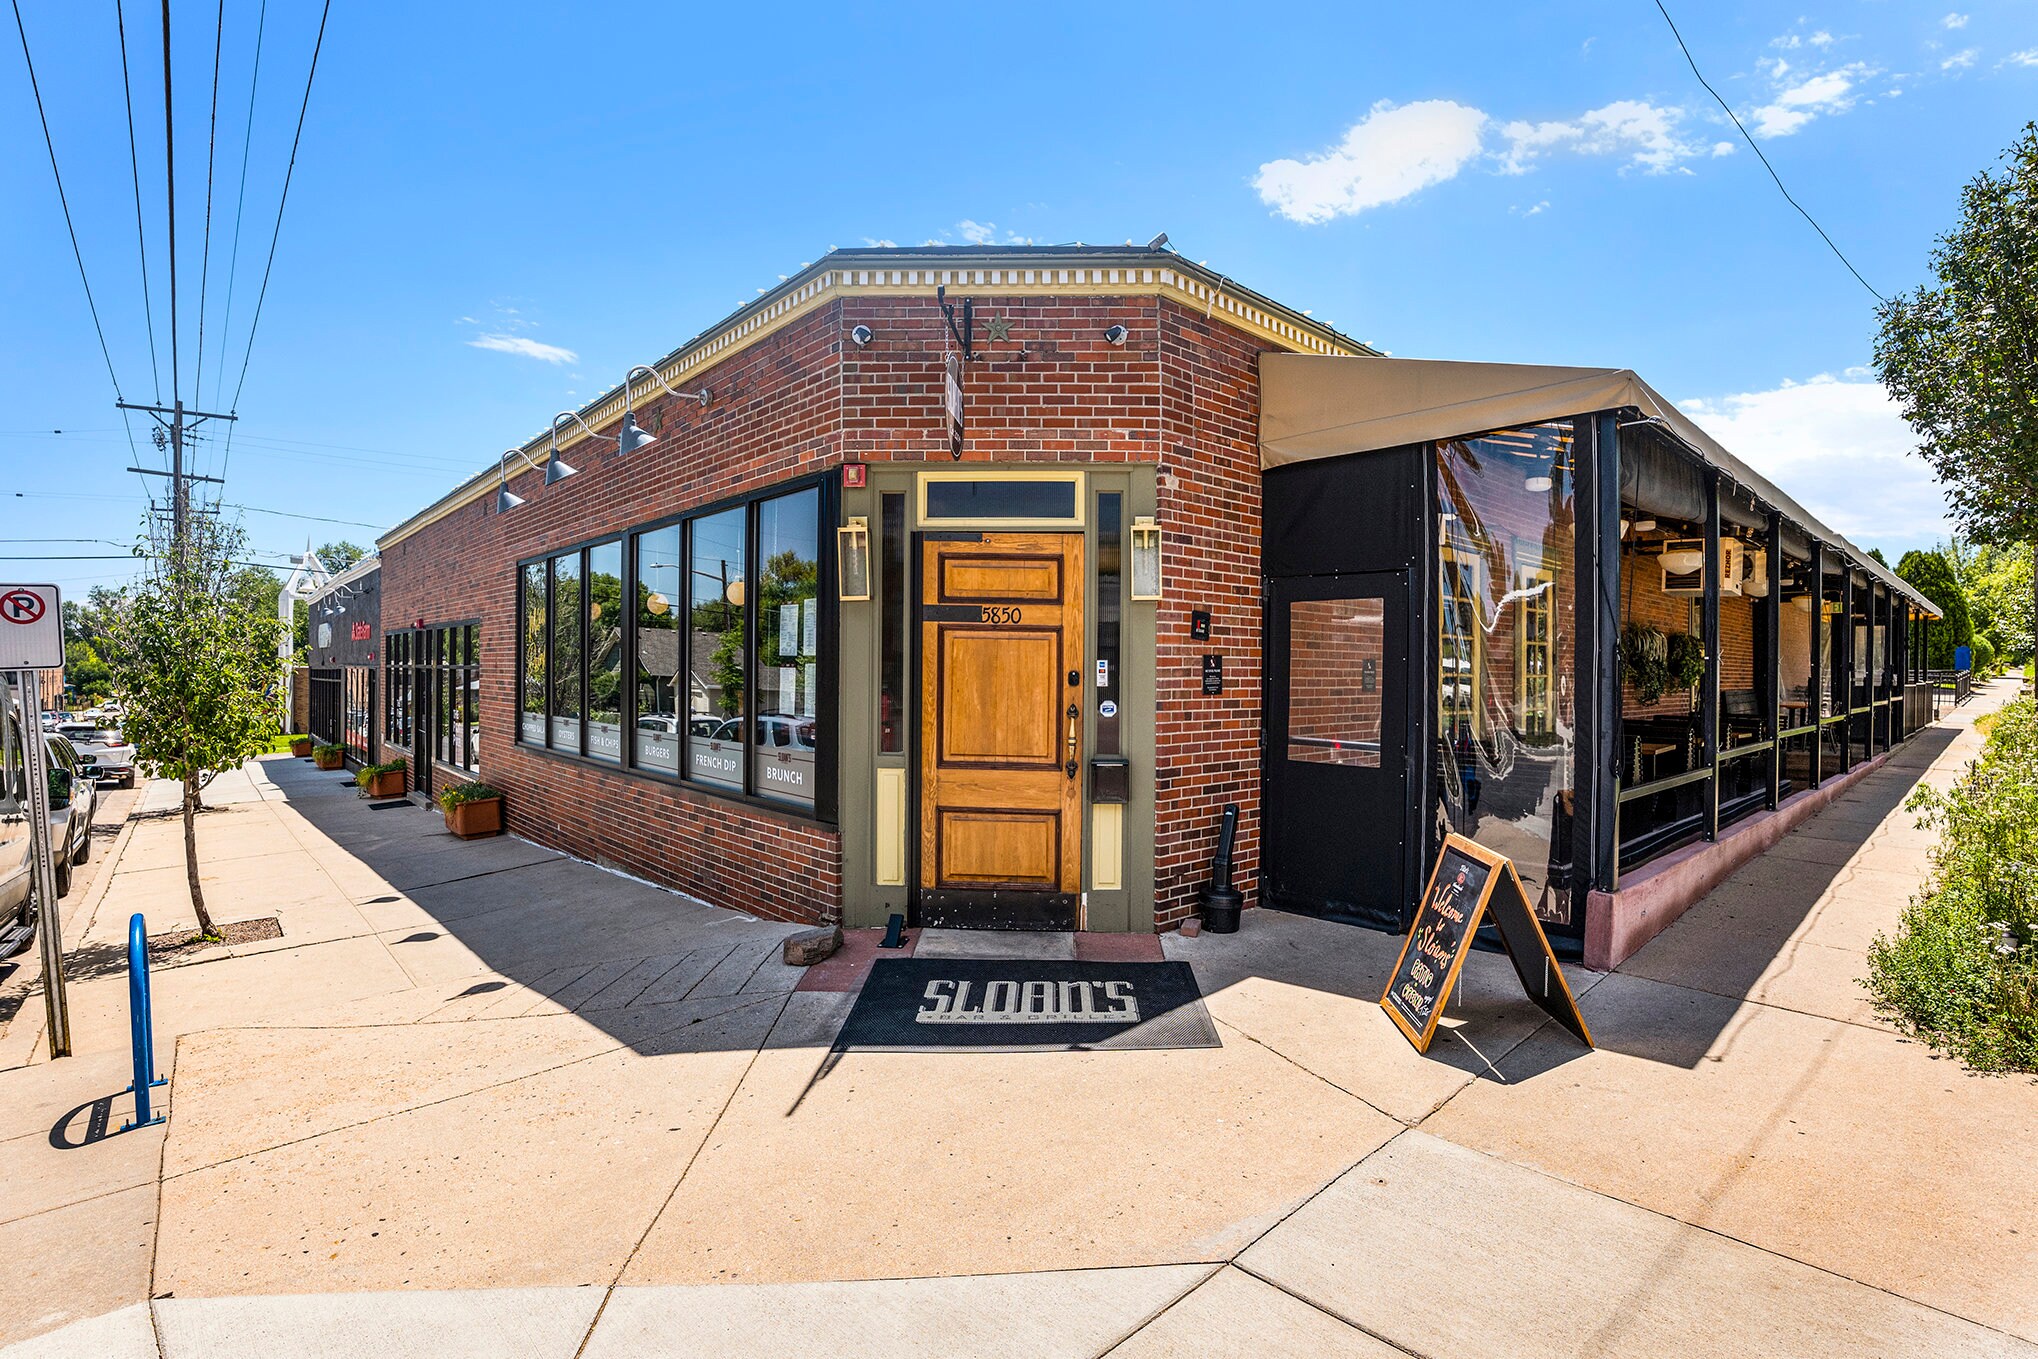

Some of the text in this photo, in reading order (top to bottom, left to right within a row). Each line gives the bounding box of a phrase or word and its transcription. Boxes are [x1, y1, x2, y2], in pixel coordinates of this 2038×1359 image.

[981, 607, 1022, 624] 5850
[558, 729, 575, 741] OYSTERS
[590, 735, 600, 746] FISH
[605, 738, 619, 749] CHIPS
[644, 745, 670, 759] BURGERS
[695, 754, 737, 772] FRENCH DIP
[766, 766, 803, 785] BRUNCH
[1431, 883, 1464, 923] Welcome
[1436, 917, 1446, 932] to
[918, 979, 1139, 1014] SLOAN'S
